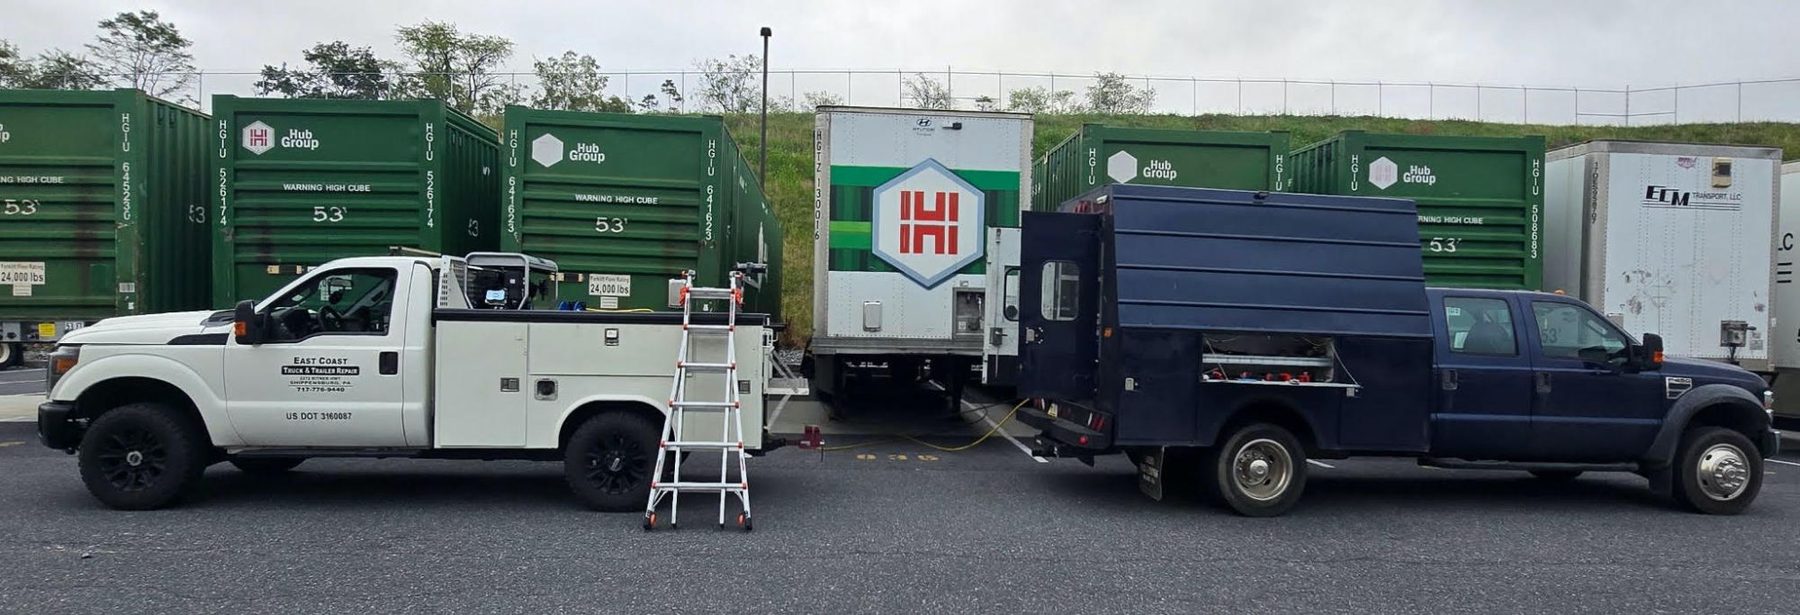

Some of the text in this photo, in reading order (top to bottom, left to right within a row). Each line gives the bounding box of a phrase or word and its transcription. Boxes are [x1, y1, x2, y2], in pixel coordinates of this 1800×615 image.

[122, 113, 130, 152] HGIU
[289, 129, 312, 139] Hub
[281, 136, 319, 150] Group
[425, 123, 434, 161] HGIU
[510, 130, 518, 167] HGIU
[577, 143, 599, 153] Hub
[570, 150, 605, 164] Group
[1150, 160, 1171, 170] Hub
[1410, 165, 1431, 175] Hub
[219, 120, 227, 226] HGIU 526174
[1143, 167, 1177, 180] Group
[1351, 154, 1359, 191] HGIU
[1403, 172, 1436, 185] Group
[17, 176, 38, 184] HIGH
[40, 176, 64, 184] CUBE
[575, 194, 612, 202] WARNING
[1645, 185, 1690, 206] ECM
[1, 272, 44, 282] 24,000 lbs
[590, 283, 629, 294] 24,000 lbs
[286, 412, 352, 420] US DOT 3160087
